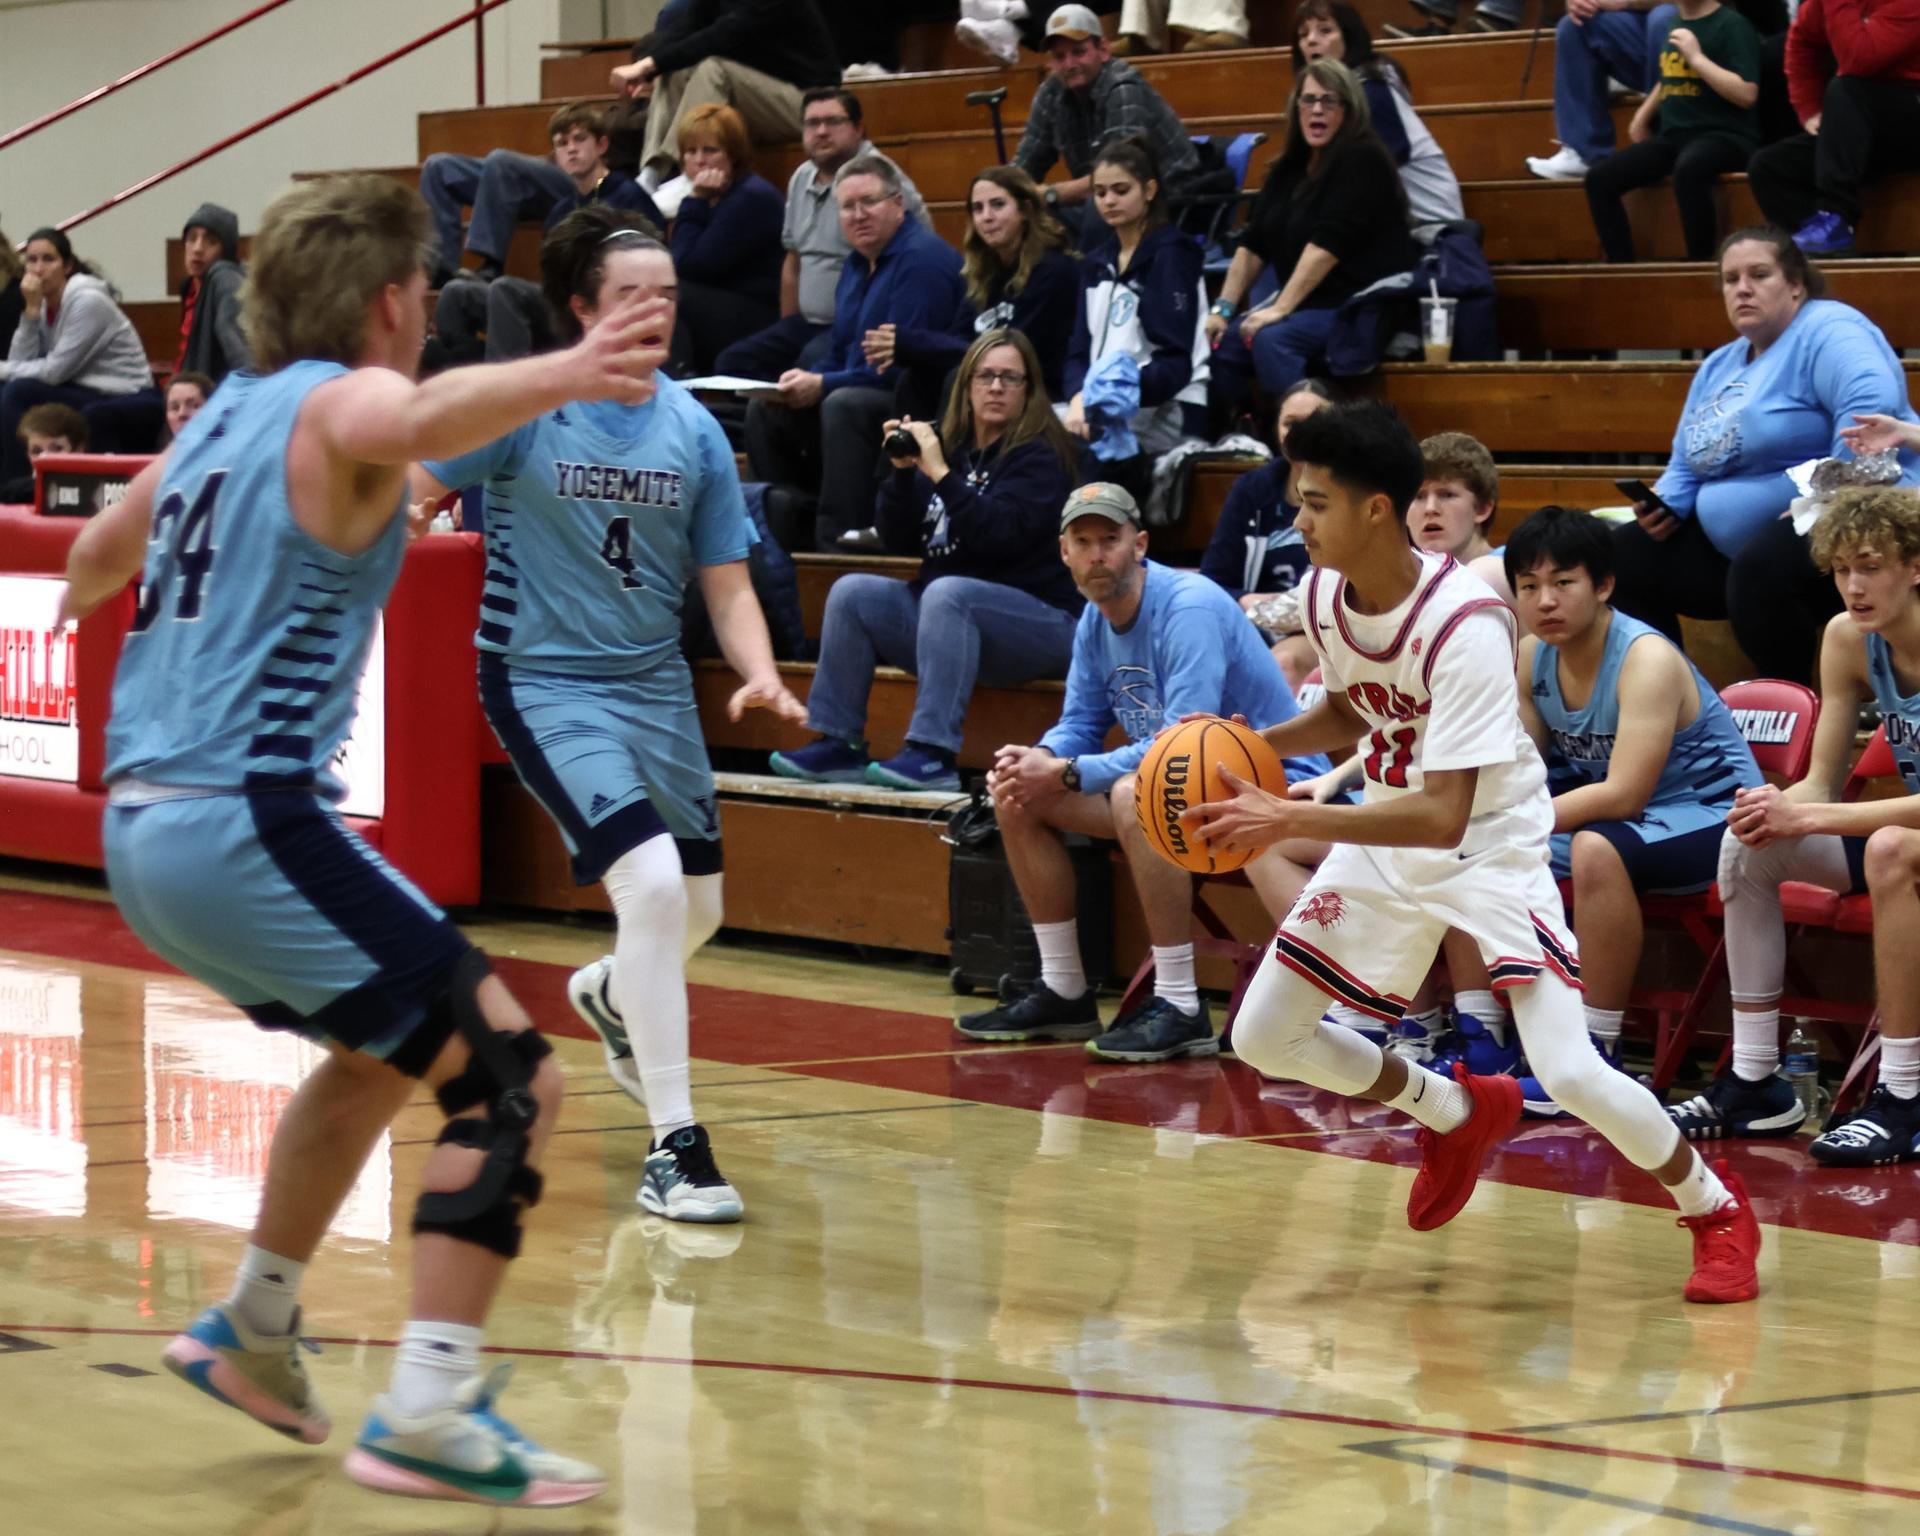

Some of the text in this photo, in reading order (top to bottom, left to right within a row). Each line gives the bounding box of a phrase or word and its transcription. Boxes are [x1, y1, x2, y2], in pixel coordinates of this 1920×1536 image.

[553, 460, 682, 510] YOSEMITE
[599, 514, 648, 592] 4
[1363, 726, 1417, 789] 11
[1163, 753, 1192, 855] Wilson
